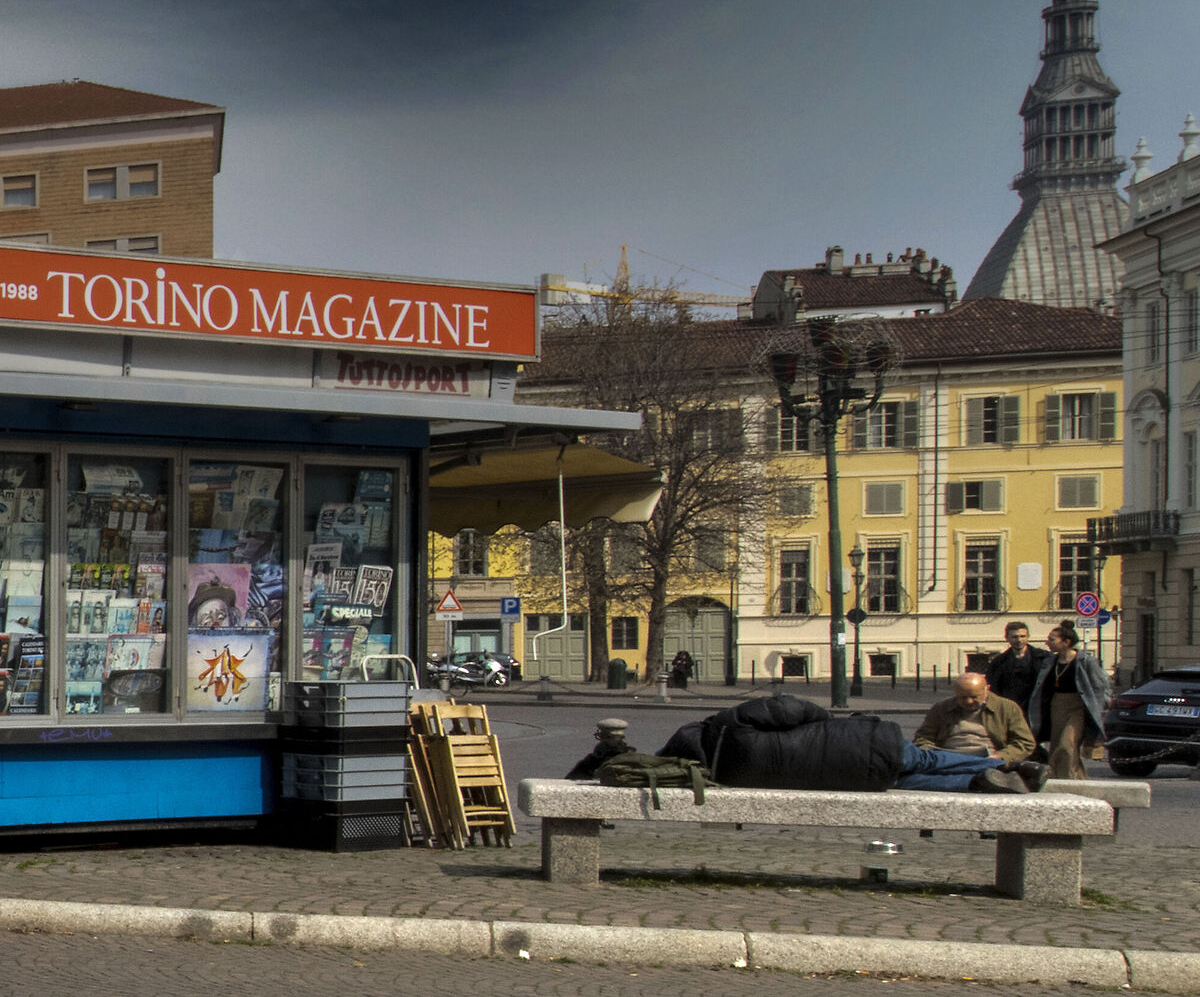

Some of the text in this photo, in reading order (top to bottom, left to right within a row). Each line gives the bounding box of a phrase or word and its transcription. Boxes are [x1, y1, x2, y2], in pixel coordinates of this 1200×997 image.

[0, 282, 38, 301] 1988
[248, 287, 491, 348] MAGAZINE
[337, 351, 472, 393] TUTTOSPORT
[357, 578, 388, 607] 150
[504, 599, 517, 613] P
[331, 607, 372, 619] SPECIALE
